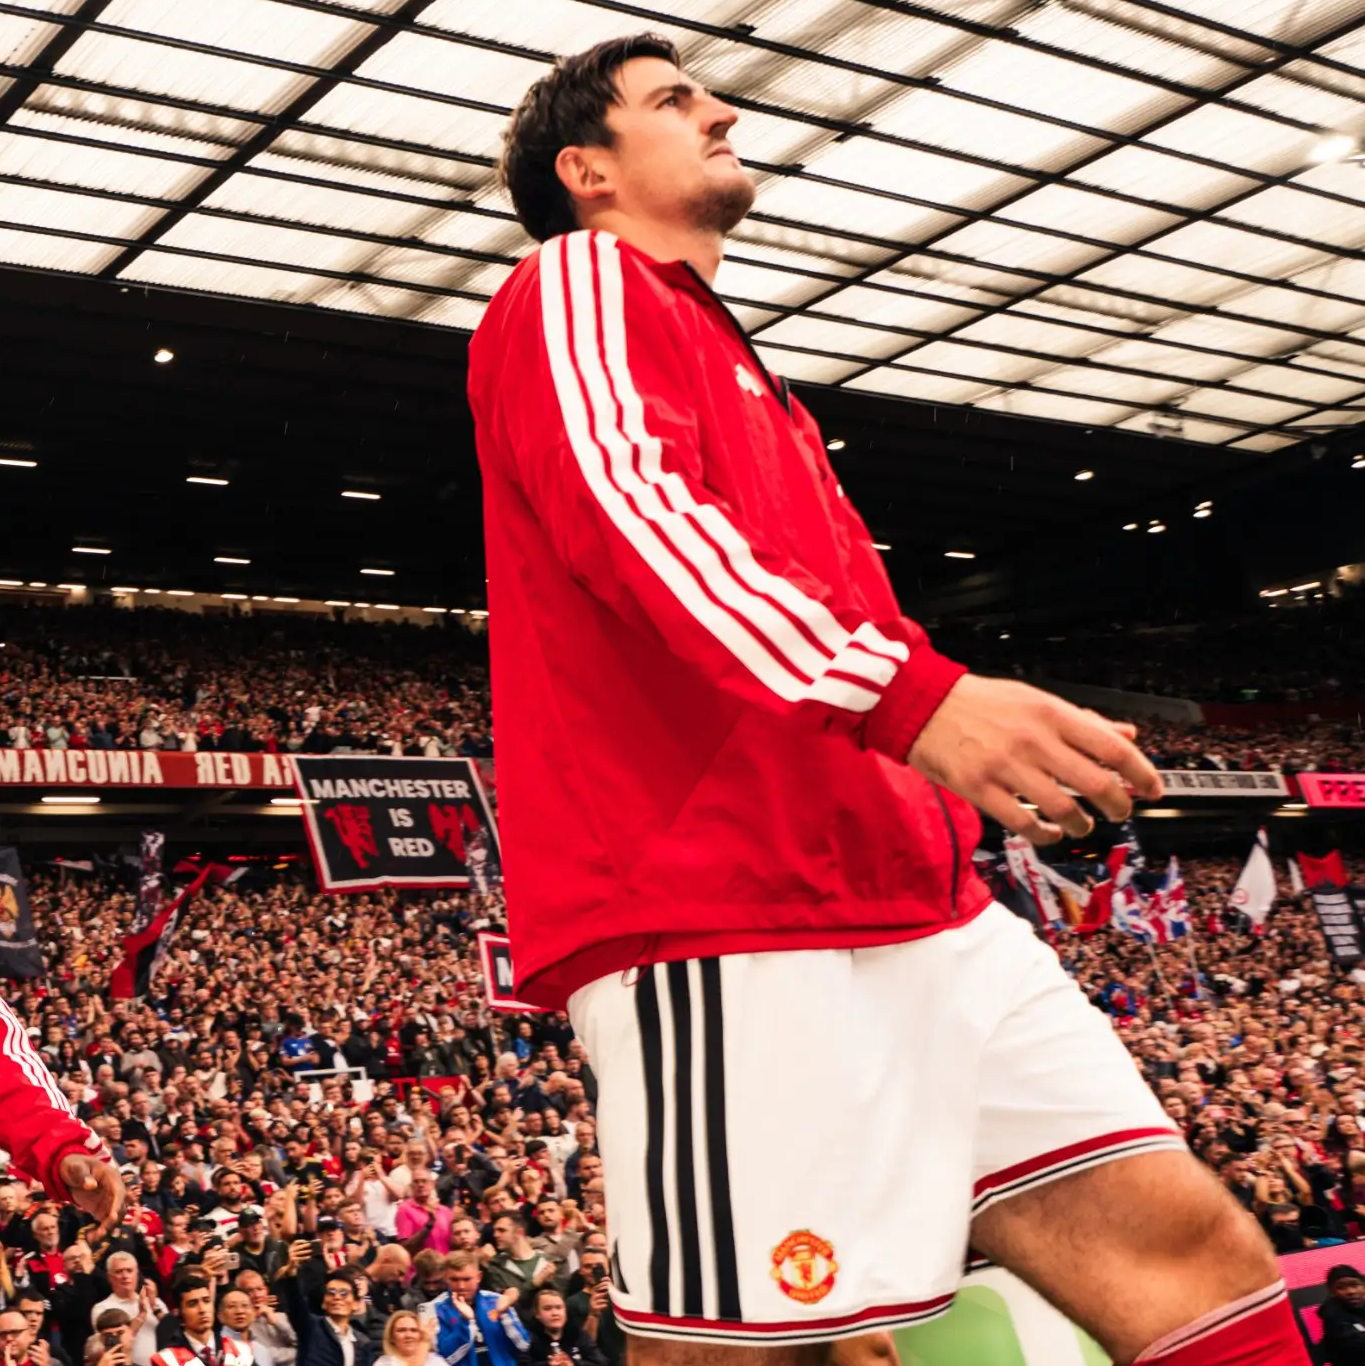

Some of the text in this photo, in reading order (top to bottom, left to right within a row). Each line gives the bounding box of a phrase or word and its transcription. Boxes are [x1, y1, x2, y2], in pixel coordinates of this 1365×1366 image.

[308, 778, 472, 799] MANCHESTER
[387, 808, 415, 828] IS
[387, 837, 436, 858] RED
